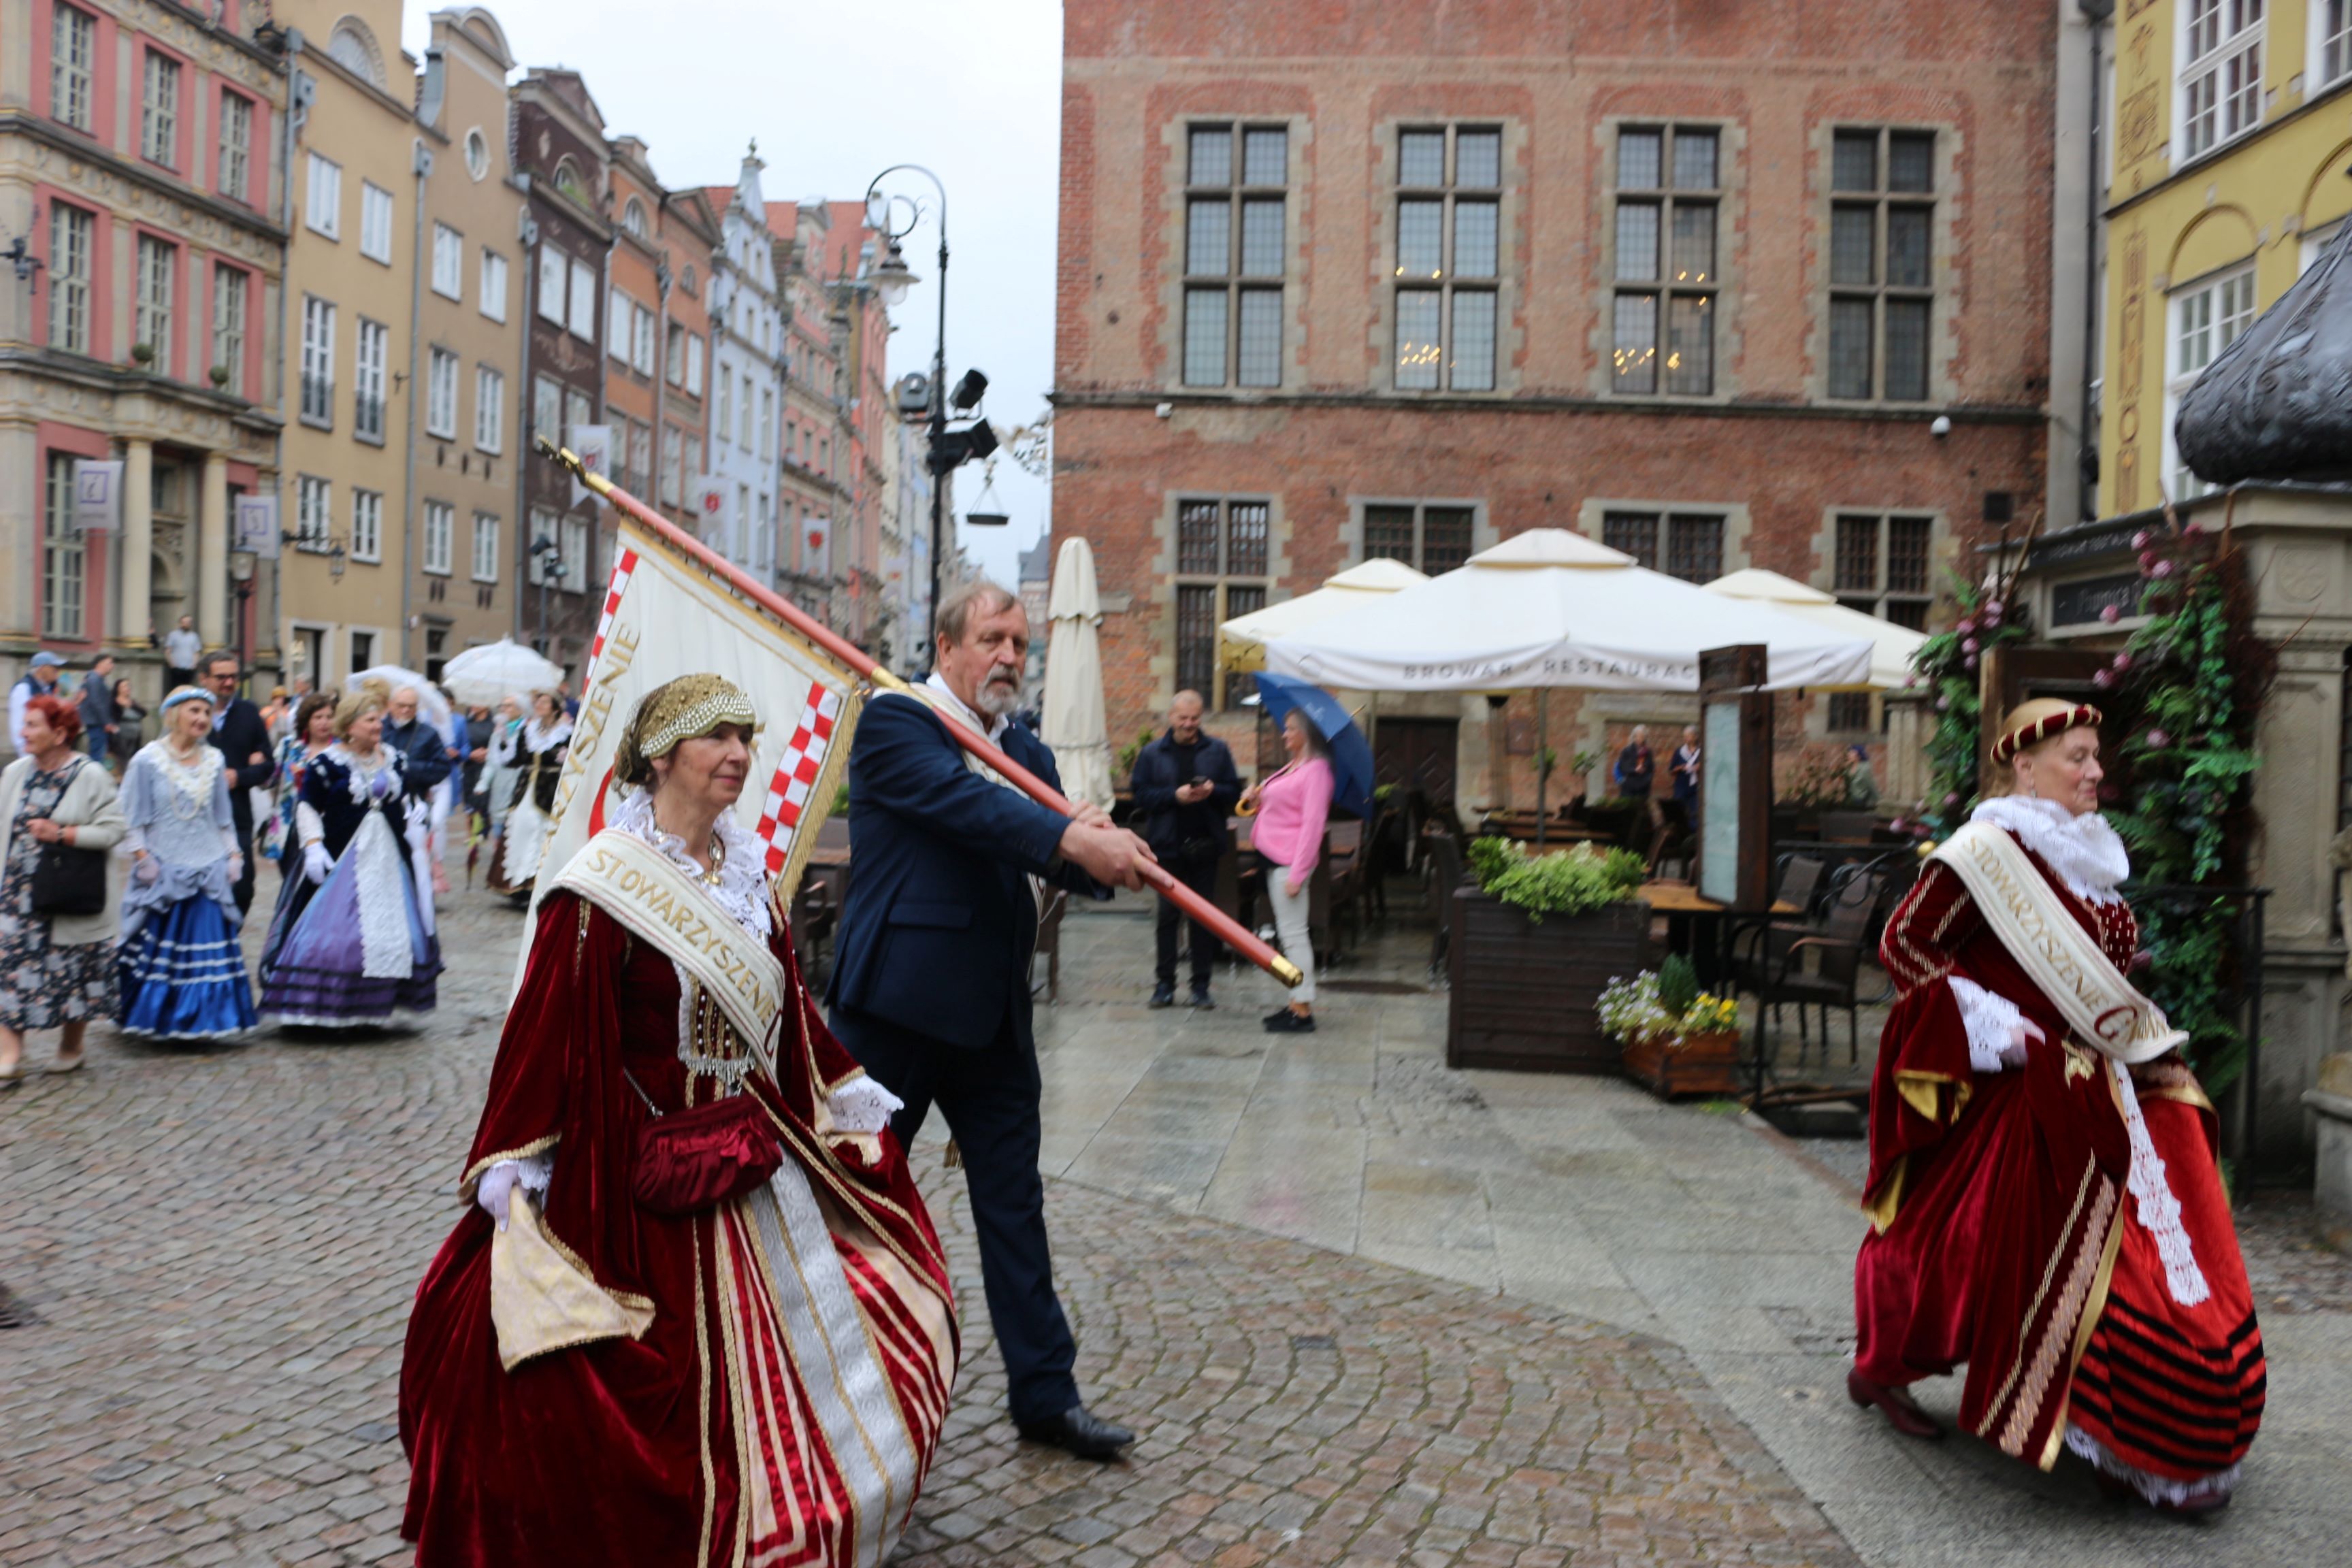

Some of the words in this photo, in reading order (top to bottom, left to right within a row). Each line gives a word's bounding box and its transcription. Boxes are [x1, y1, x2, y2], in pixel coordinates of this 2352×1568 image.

[544, 622, 641, 859] RZYSZENIE
[1404, 661, 1512, 680] BROWAR
[1544, 659, 1695, 680] RESTAURAC
[586, 848, 776, 1030] STOWARZYSZENIE
[1962, 837, 2110, 1013] STOWARZYSZENIE
